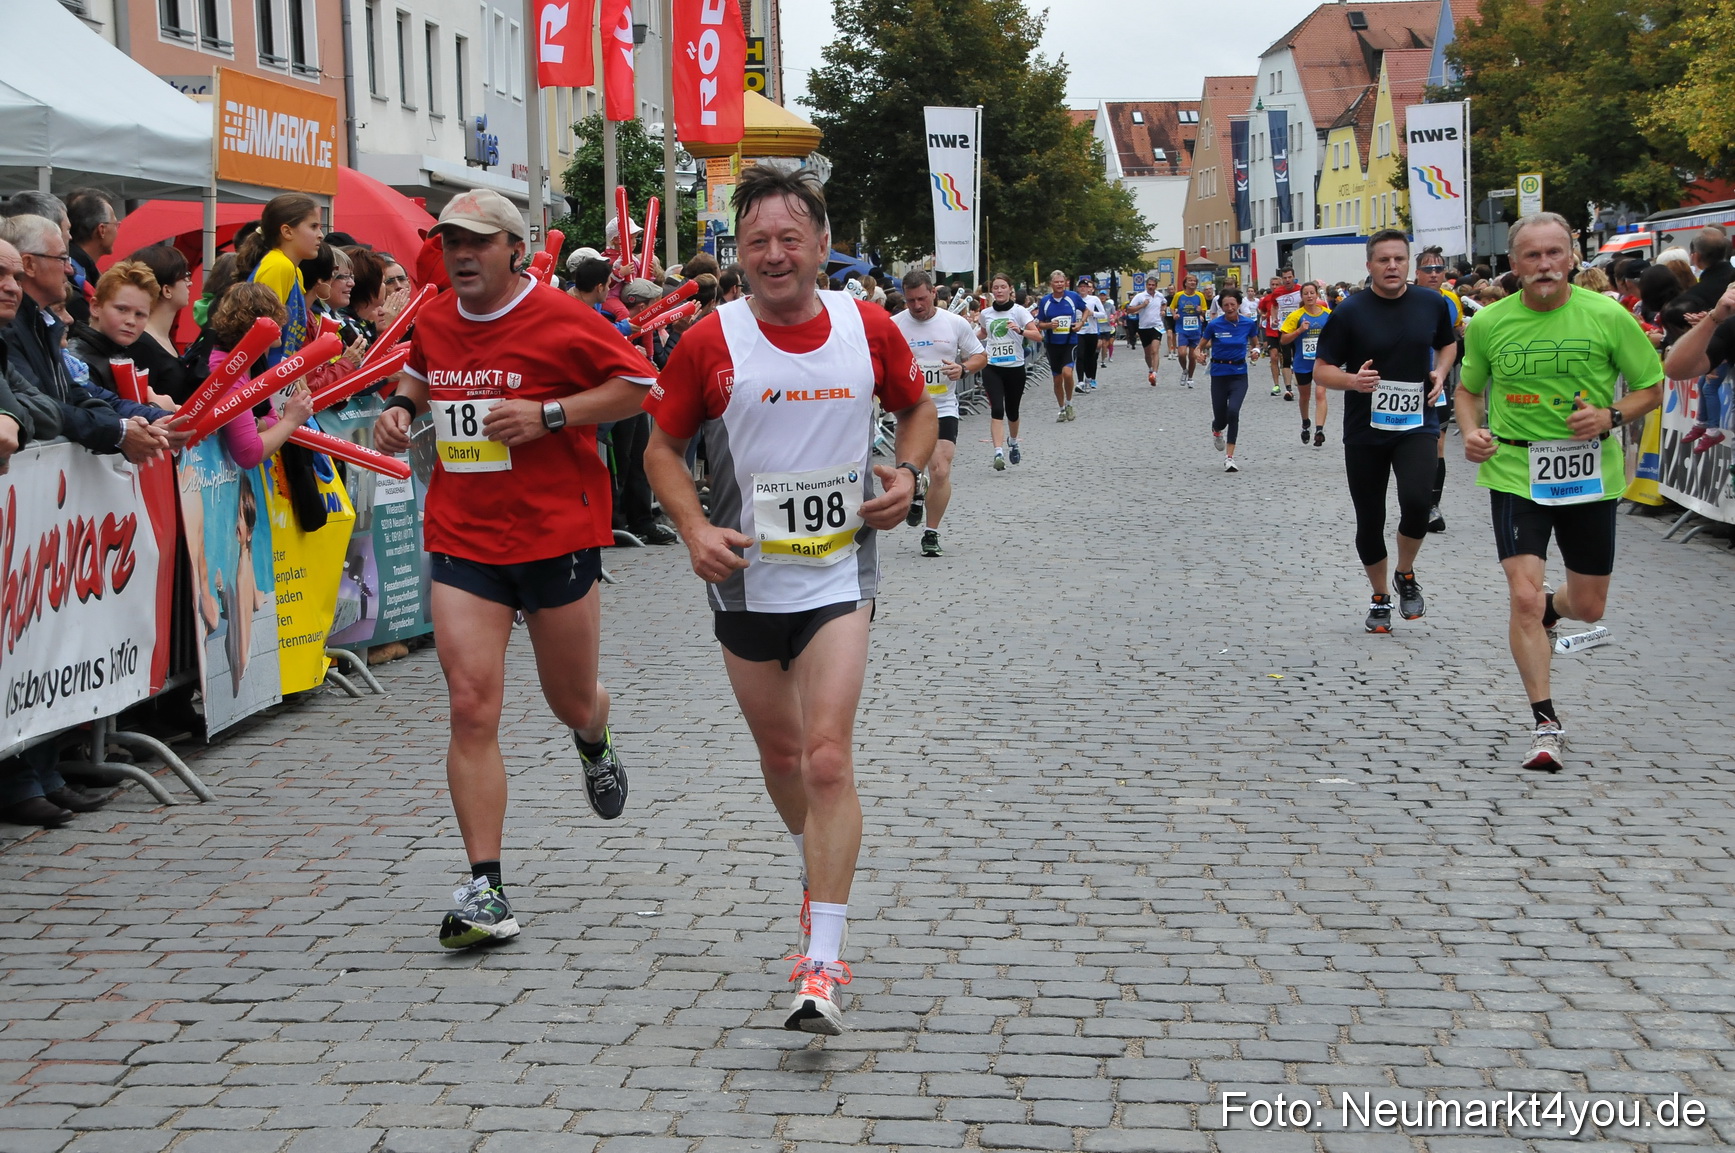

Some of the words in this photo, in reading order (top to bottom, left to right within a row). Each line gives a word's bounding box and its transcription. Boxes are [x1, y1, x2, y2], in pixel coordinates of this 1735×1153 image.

[223, 100, 333, 168] RUNMARKT.DE
[992, 345, 1014, 356] 2156
[202, 378, 224, 401] BKK
[213, 395, 241, 418] Audi
[243, 378, 269, 399] BKK
[786, 388, 856, 401] KLEBL
[1377, 392, 1420, 412] 2033
[445, 403, 478, 437] 18
[1385, 416, 1408, 424] Robert
[447, 446, 480, 462] Charly
[1530, 446, 1555, 454] PARTL
[1556, 444, 1589, 453] Neumarkt
[1537, 452, 1595, 481] 2050
[756, 483, 793, 493] PARTL
[796, 476, 845, 491] Neumarkt
[1550, 485, 1584, 496] Werner
[779, 491, 847, 533] 198
